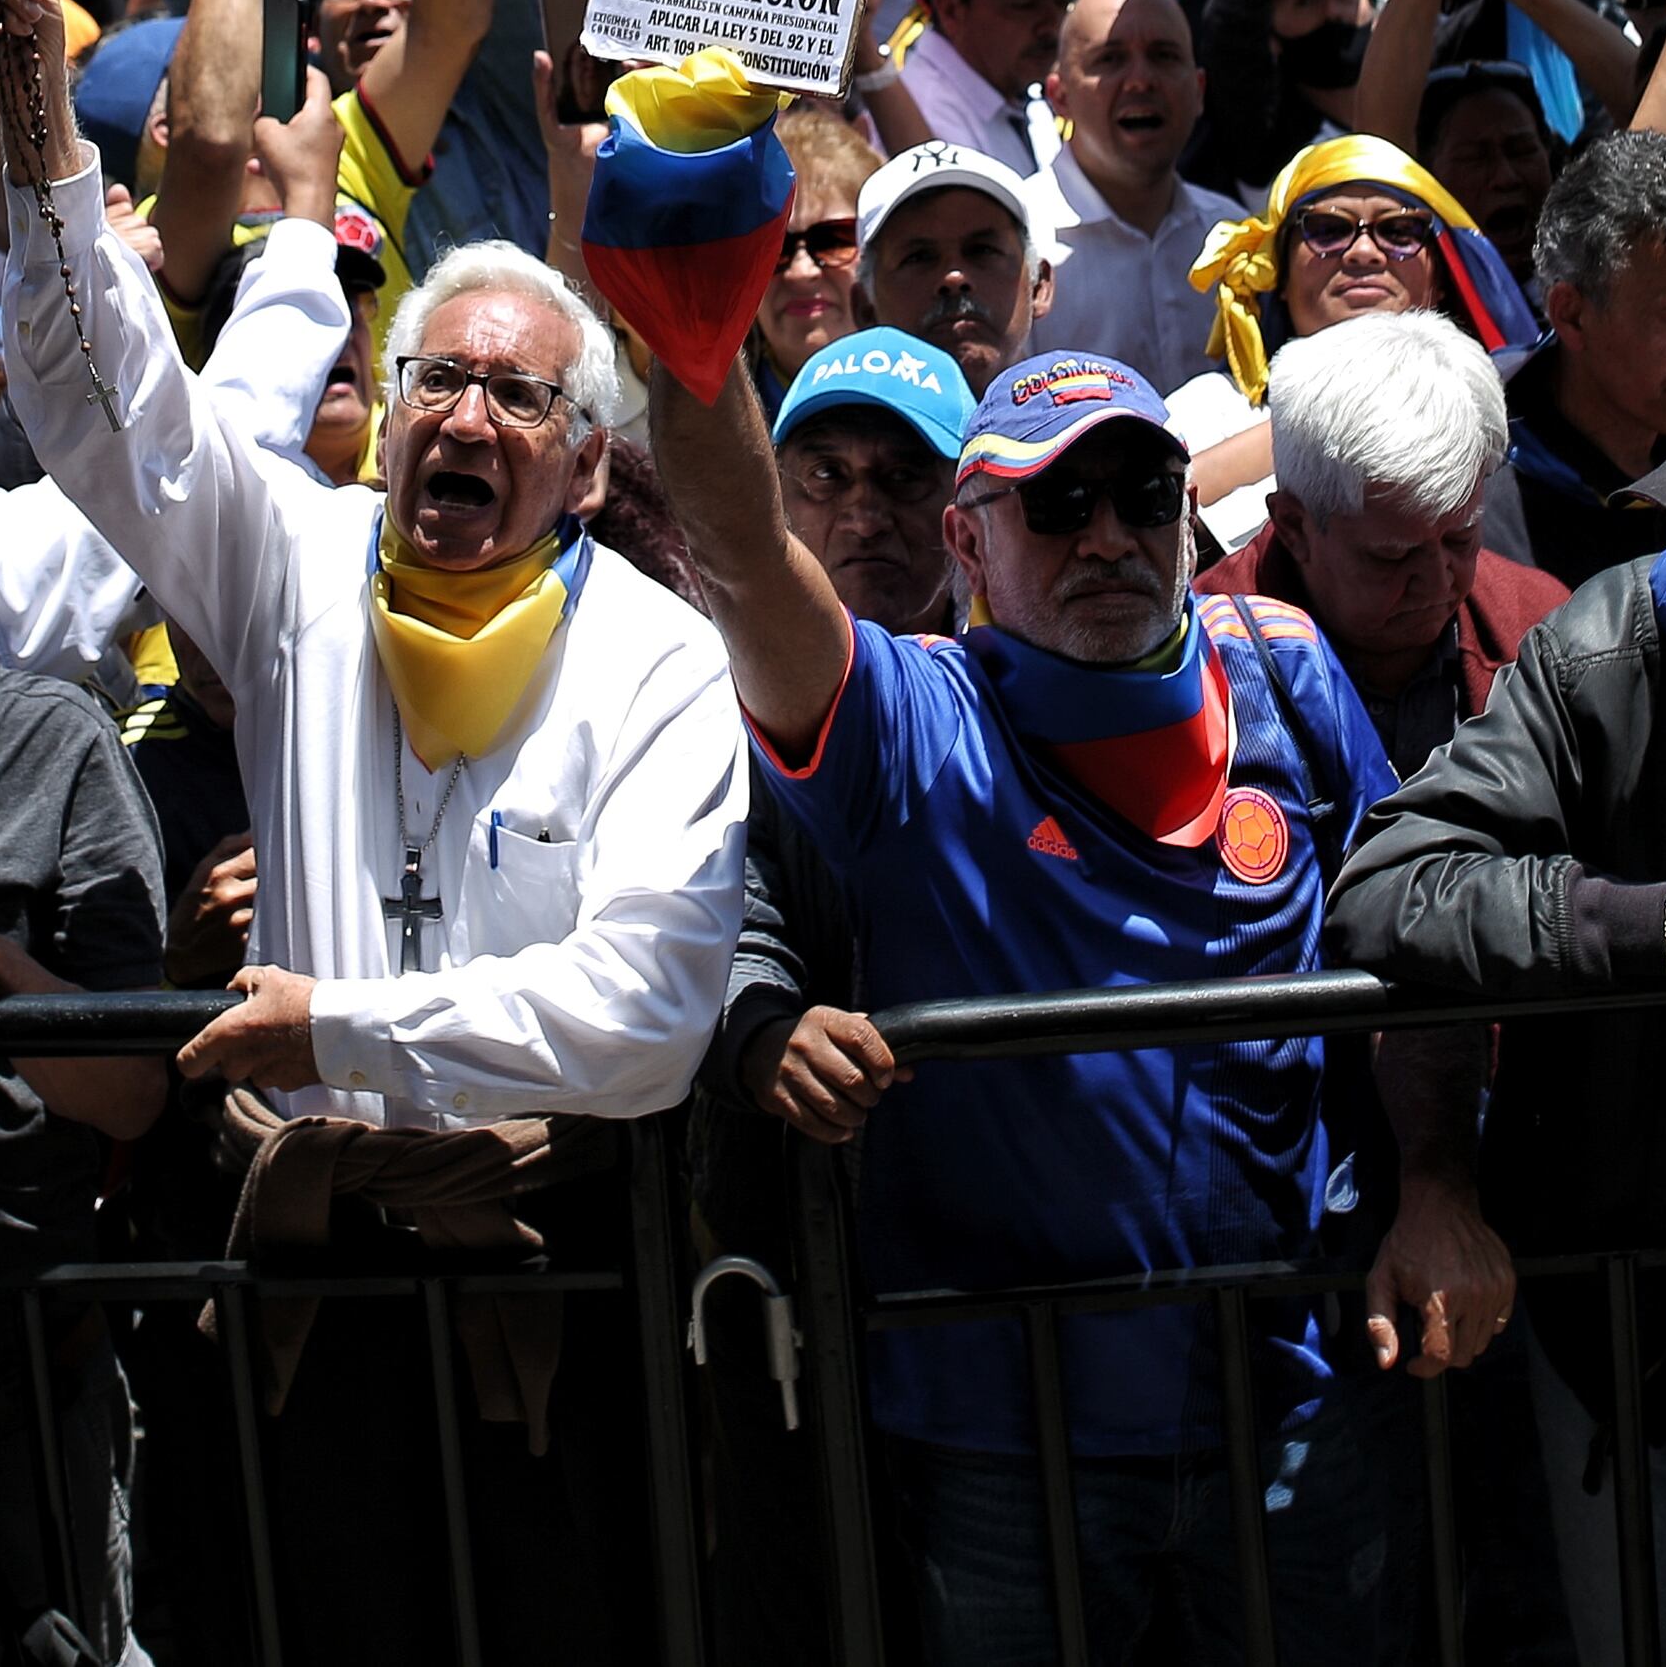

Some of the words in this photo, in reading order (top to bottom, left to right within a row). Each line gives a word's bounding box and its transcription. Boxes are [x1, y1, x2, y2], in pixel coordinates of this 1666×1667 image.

[648, 8, 700, 34] APLICAR
[702, 18, 720, 37] LA
[722, 22, 747, 43] LEY
[749, 26, 758, 43] 5
[759, 29, 784, 49] DEL
[786, 35, 803, 51] 92
[807, 38, 818, 54] Y
[819, 40, 835, 56] EL
[708, 1, 722, 14] EN
[771, 13, 839, 35] PRESIDENCIAL
[645, 33, 670, 53] ART.
[674, 39, 695, 56] 109
[812, 349, 943, 395] PALOMA
[1027, 836, 1078, 861] adidas
